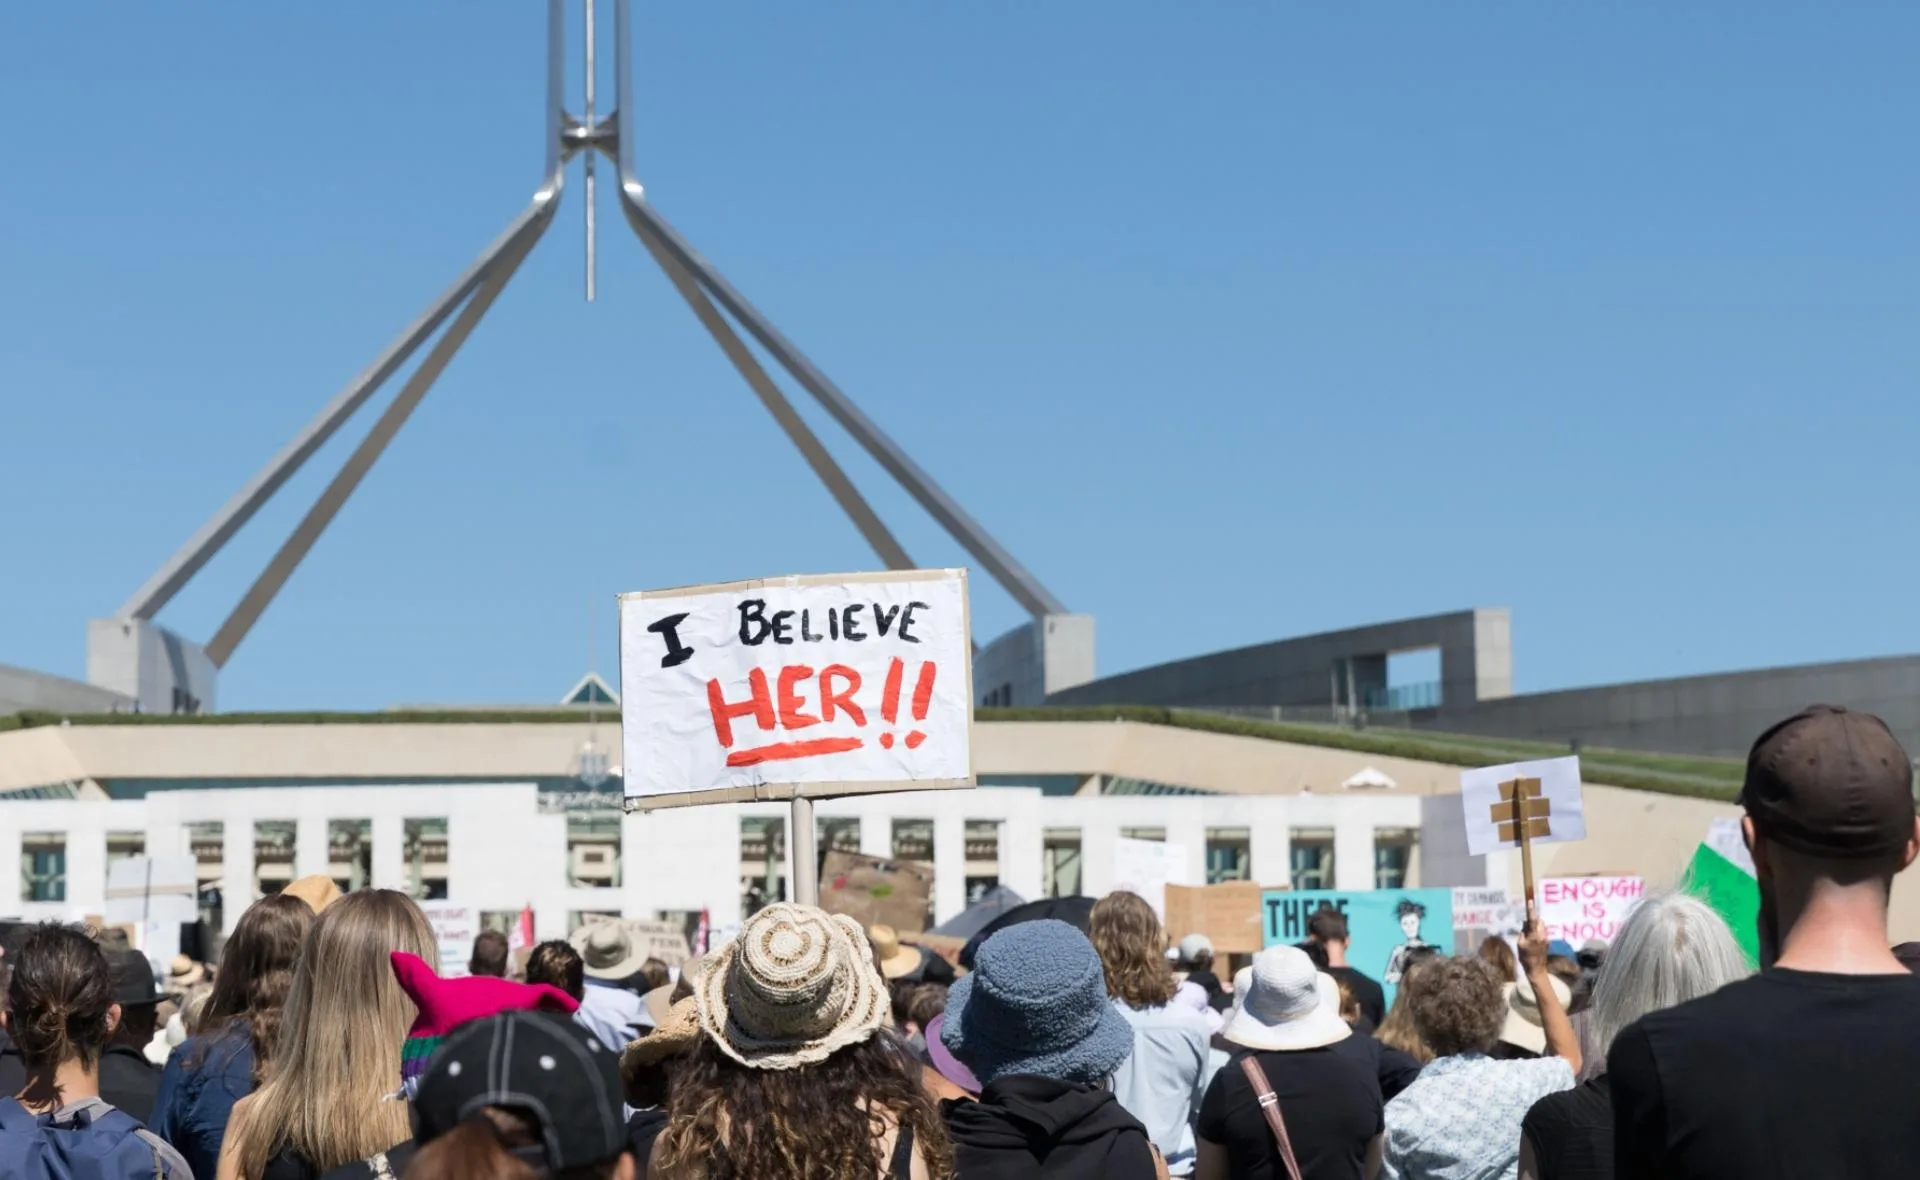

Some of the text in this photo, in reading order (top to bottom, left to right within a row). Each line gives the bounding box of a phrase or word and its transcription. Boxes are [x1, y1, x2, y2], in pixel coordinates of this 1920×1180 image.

[647, 598, 930, 668] I BELIEVE
[707, 656, 936, 749] HER!!
[1544, 879, 1643, 904] ENOUGH
[1582, 902, 1606, 918] IS
